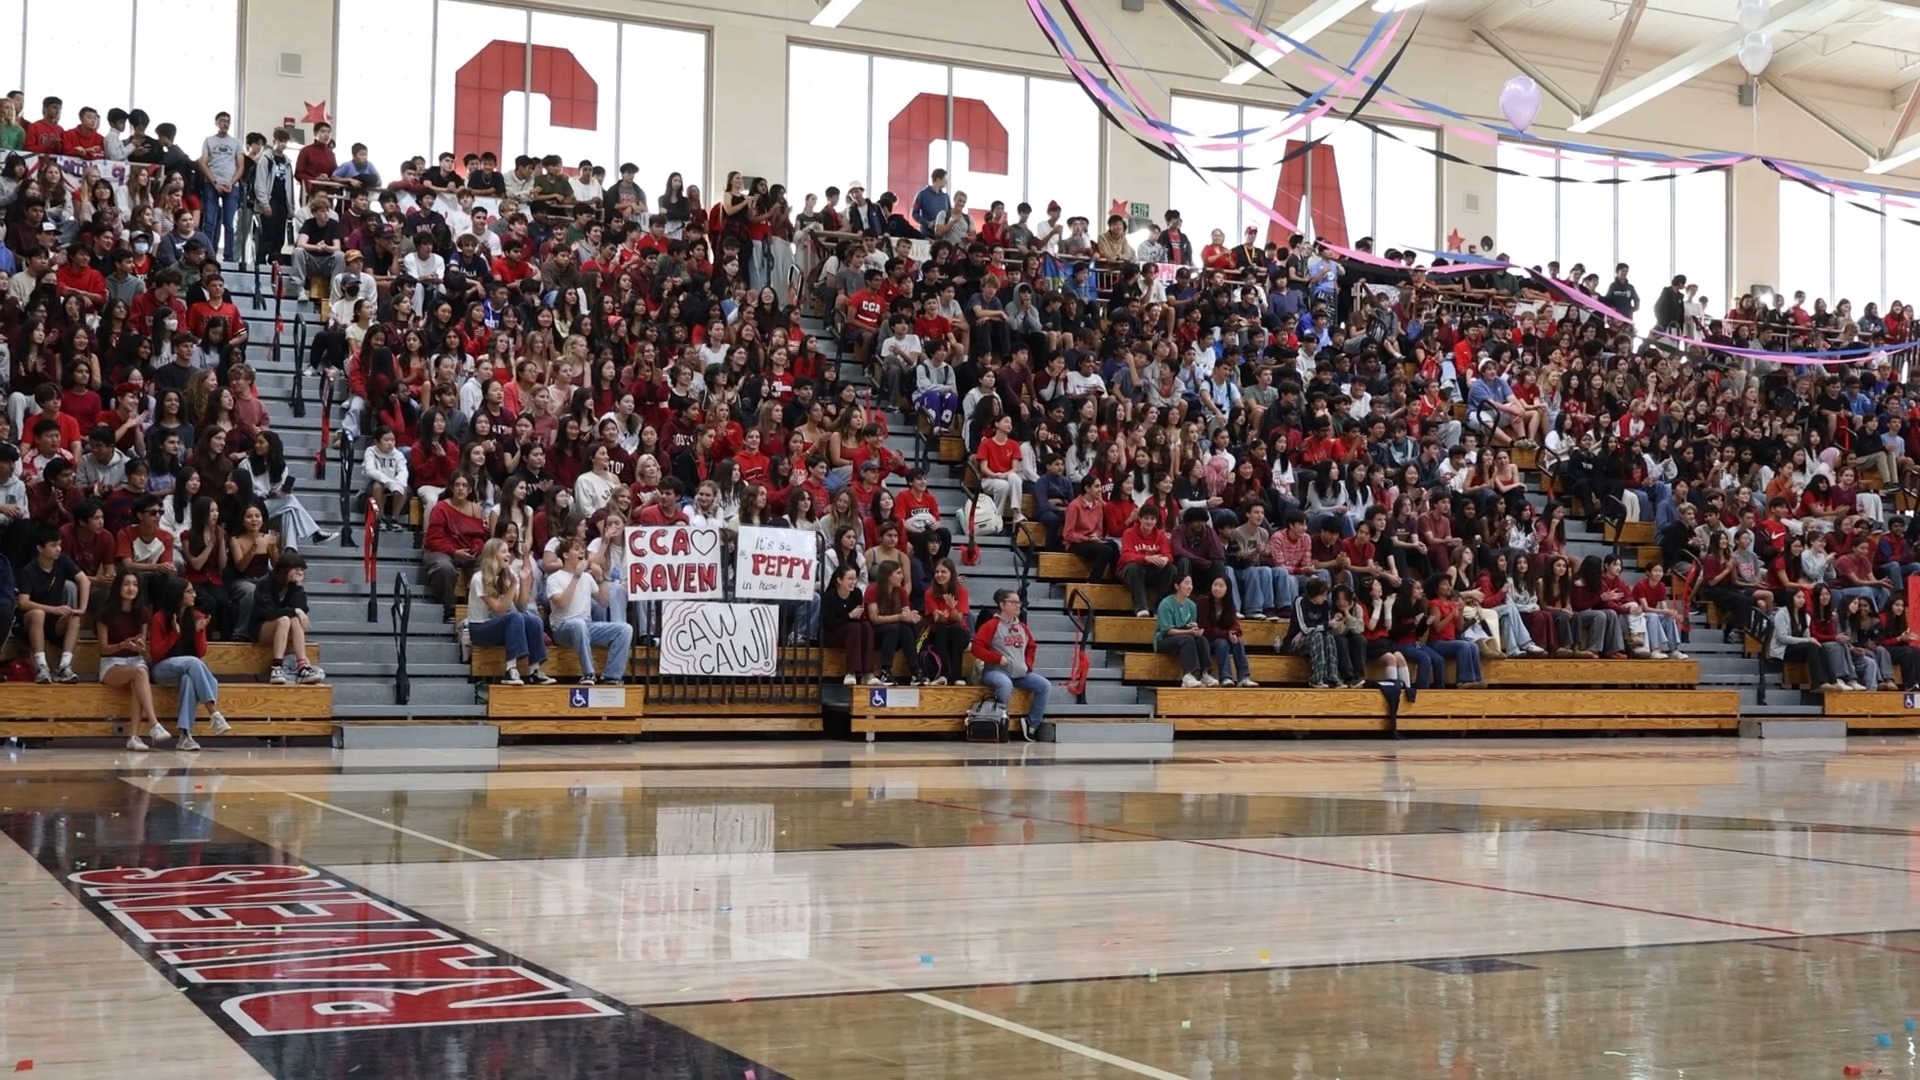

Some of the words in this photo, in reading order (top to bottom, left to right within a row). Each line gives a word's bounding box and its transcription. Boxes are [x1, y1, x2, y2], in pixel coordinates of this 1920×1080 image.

[862, 300, 881, 312] CCA
[628, 528, 691, 557] CCA
[779, 541, 792, 551] so
[629, 562, 717, 594] RAVEN
[751, 553, 814, 580] PEPPY
[742, 580, 752, 590] in
[676, 604, 737, 652] CAW
[67, 862, 625, 1037] RAVENS
